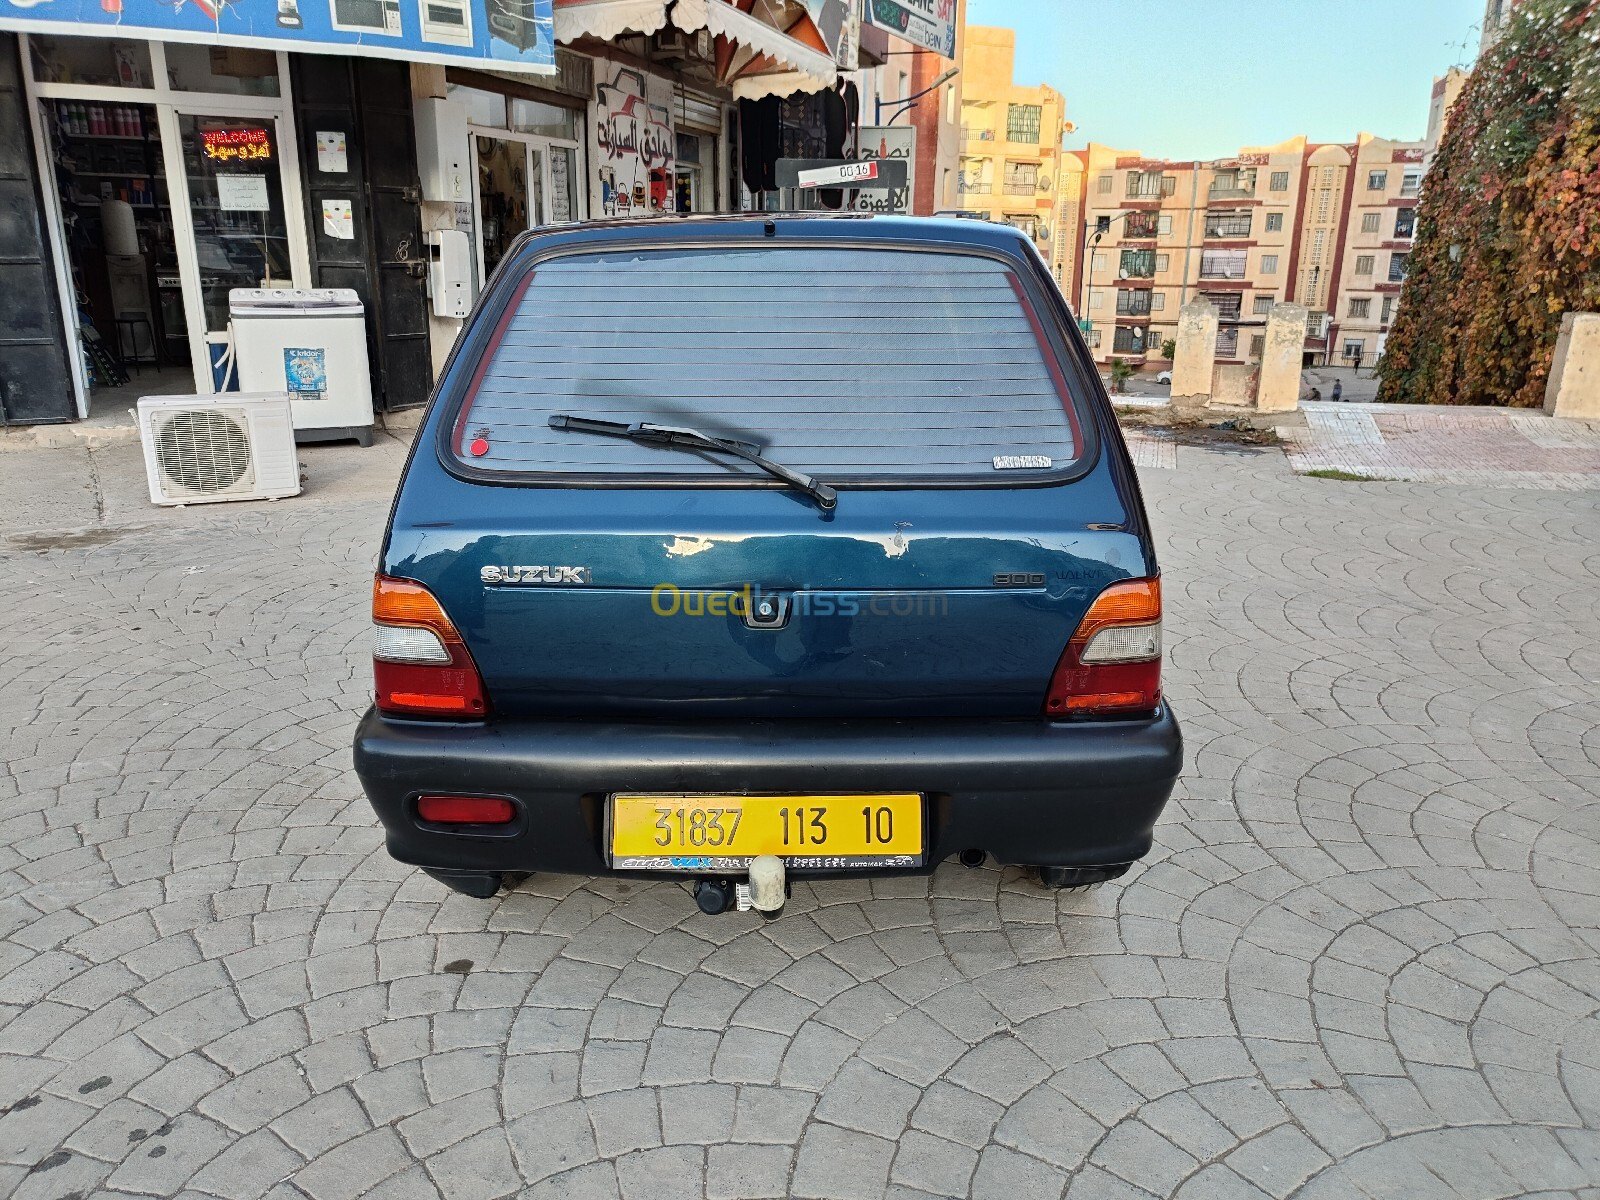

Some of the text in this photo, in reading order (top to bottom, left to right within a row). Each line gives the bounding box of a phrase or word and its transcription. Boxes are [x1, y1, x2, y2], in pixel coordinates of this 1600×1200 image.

[204, 130, 266, 143] WELCOME
[598, 119, 675, 169] لواحق السيارات
[480, 565, 593, 584] SUZUKI
[654, 806, 893, 847] 31837 113 10
